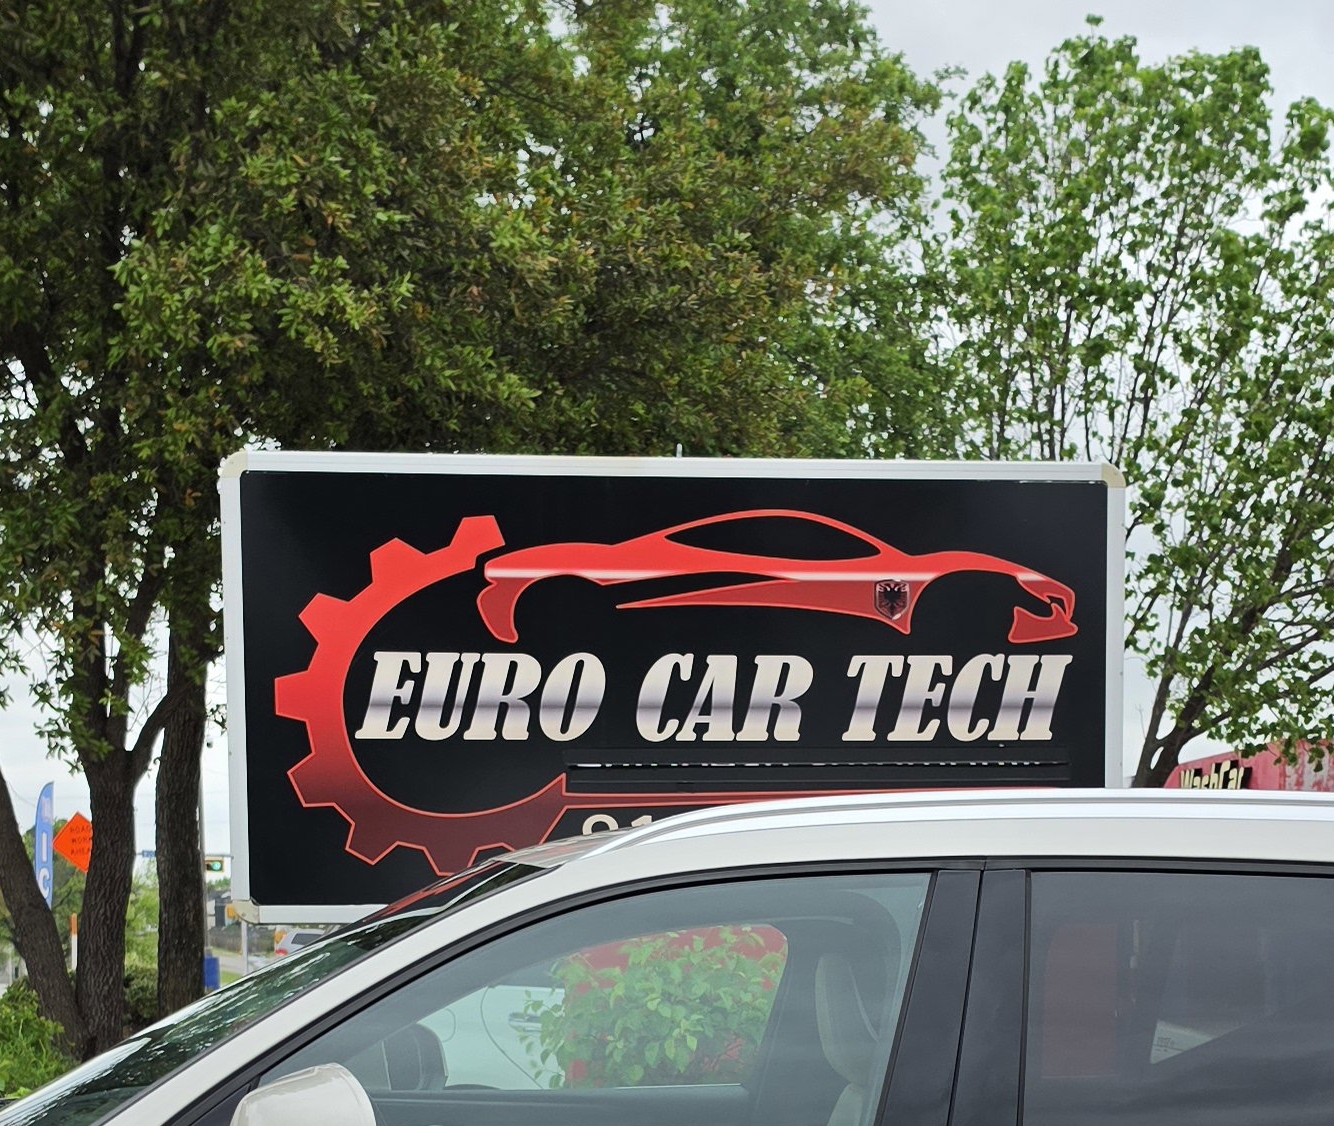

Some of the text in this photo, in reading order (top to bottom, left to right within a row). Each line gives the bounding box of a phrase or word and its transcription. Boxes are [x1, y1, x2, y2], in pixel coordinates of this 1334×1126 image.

[355, 651, 1073, 742] EURO CAR TECH
